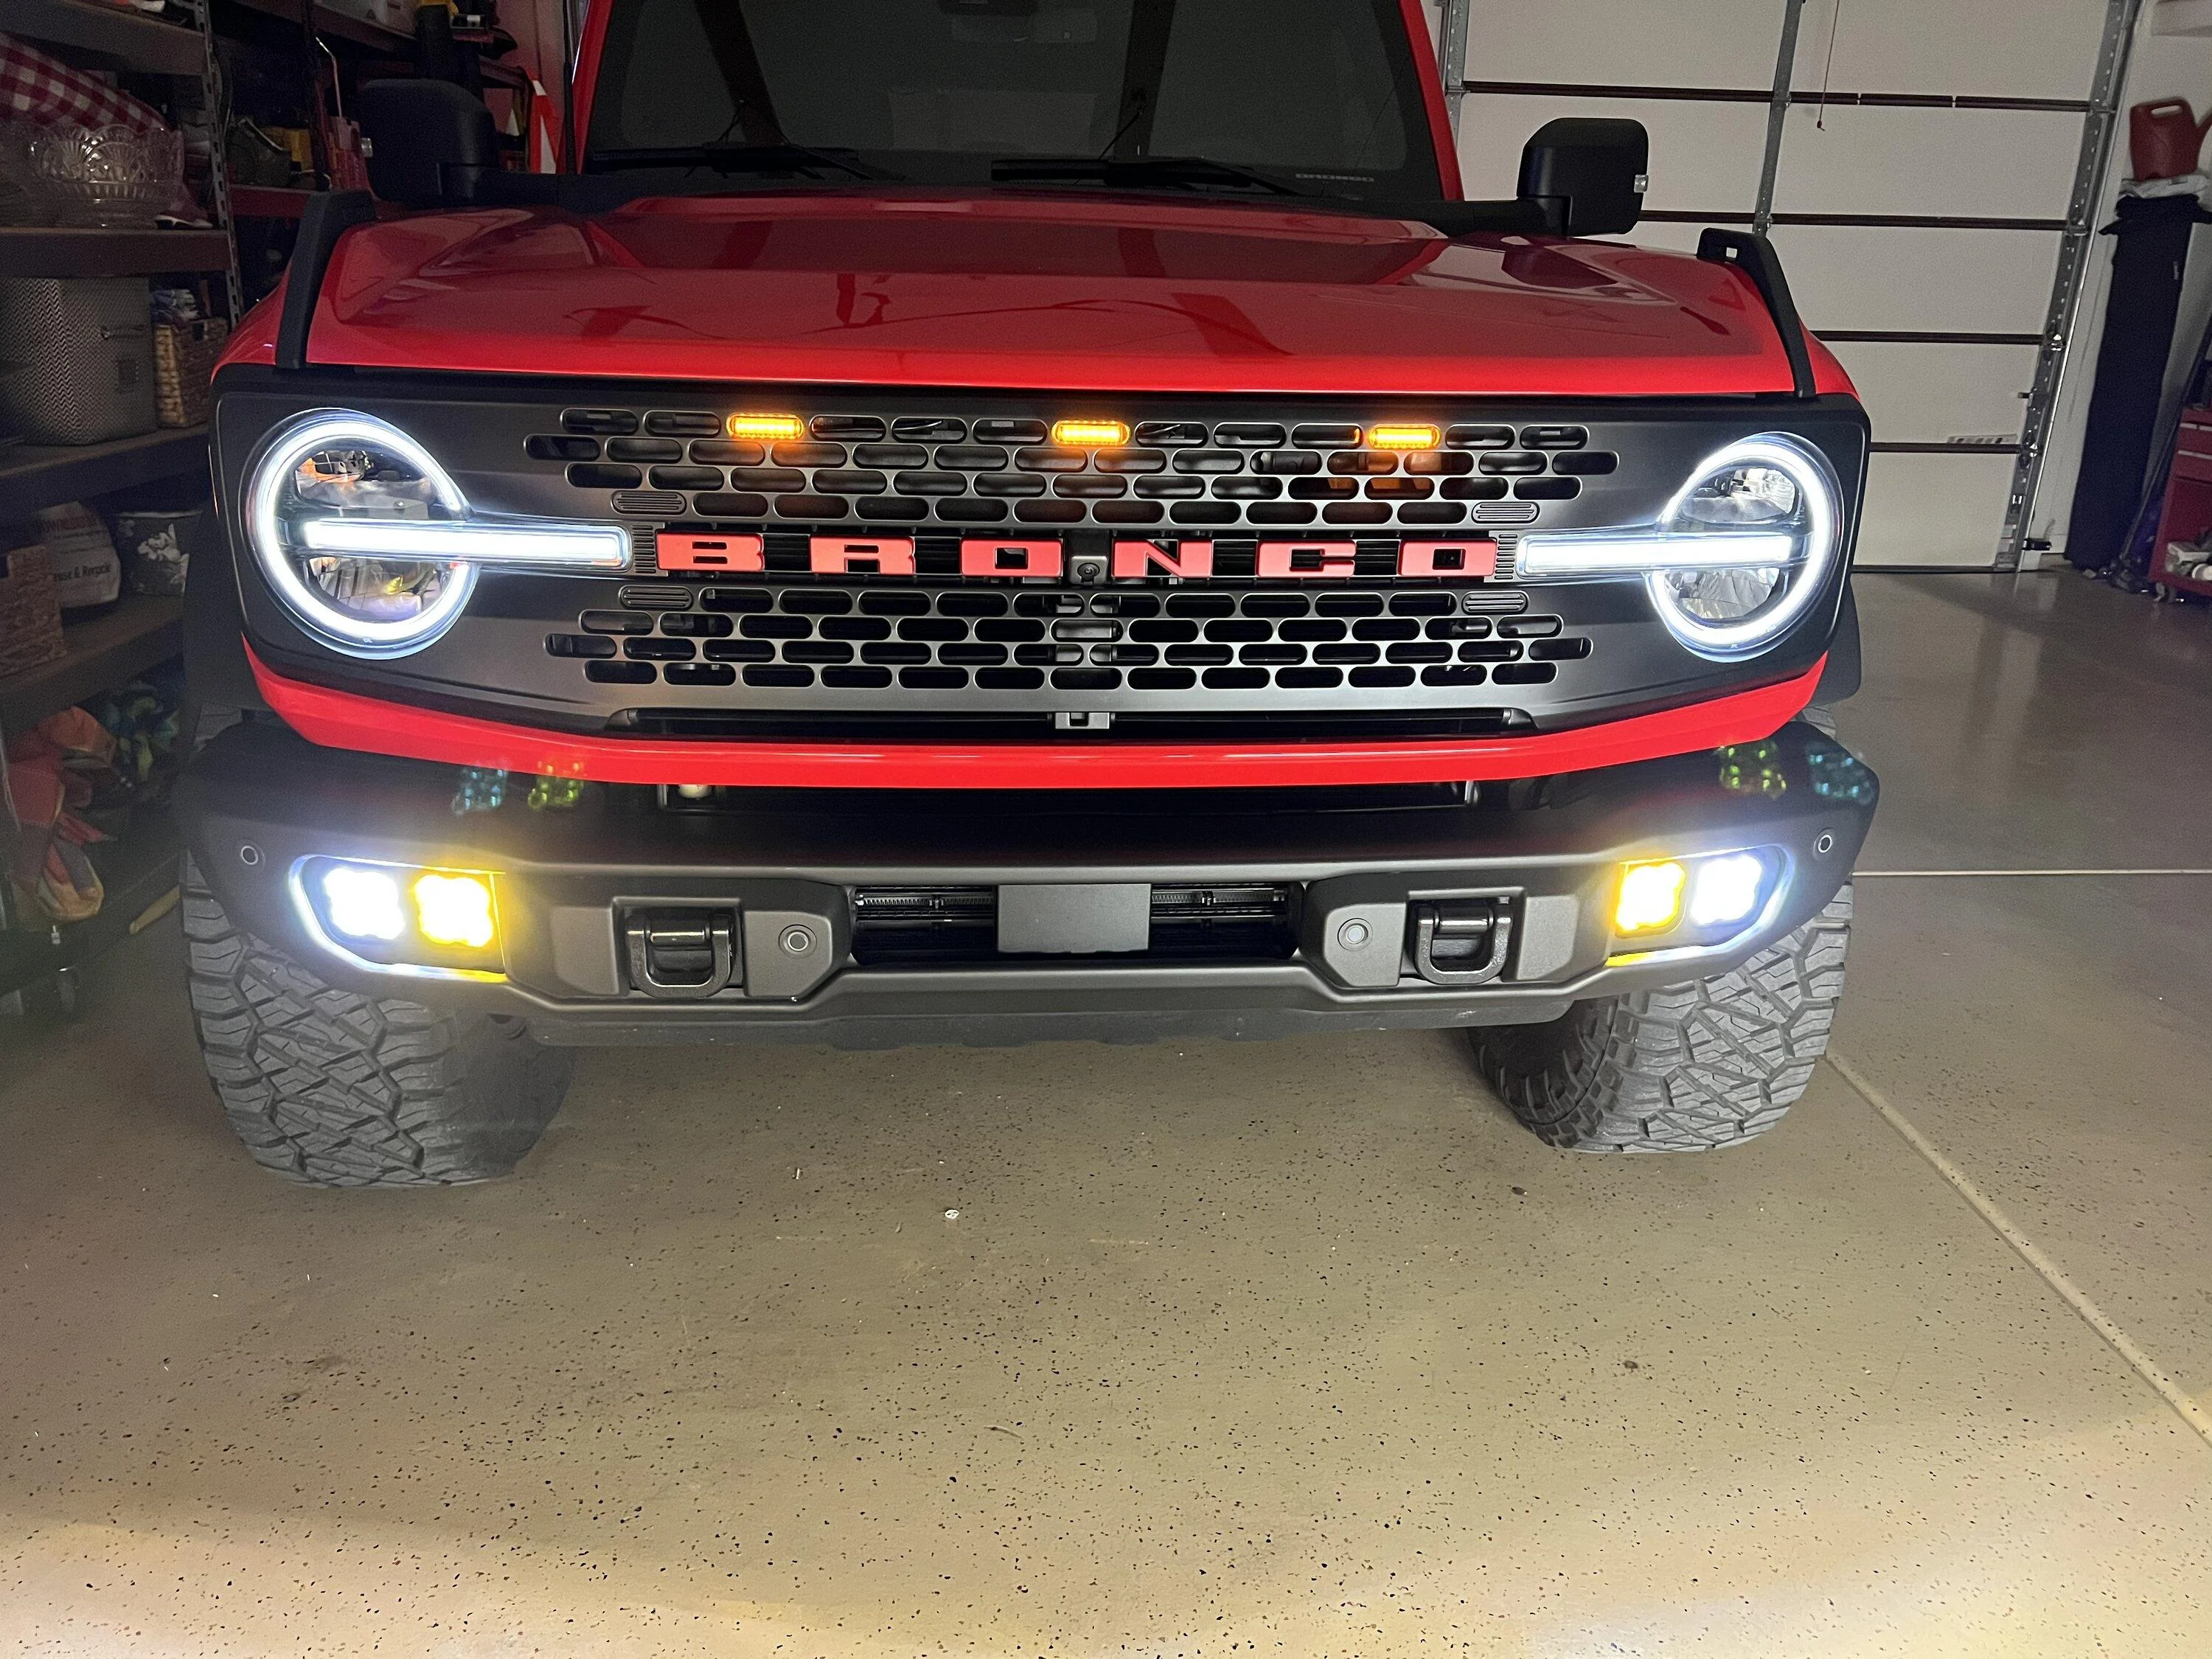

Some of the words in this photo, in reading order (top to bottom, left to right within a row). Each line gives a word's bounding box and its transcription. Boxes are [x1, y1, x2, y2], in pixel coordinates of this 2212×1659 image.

[1295, 173, 1374, 182] BRONCO
[655, 532, 1498, 578] BRONCO
[73, 566, 81, 579] &
